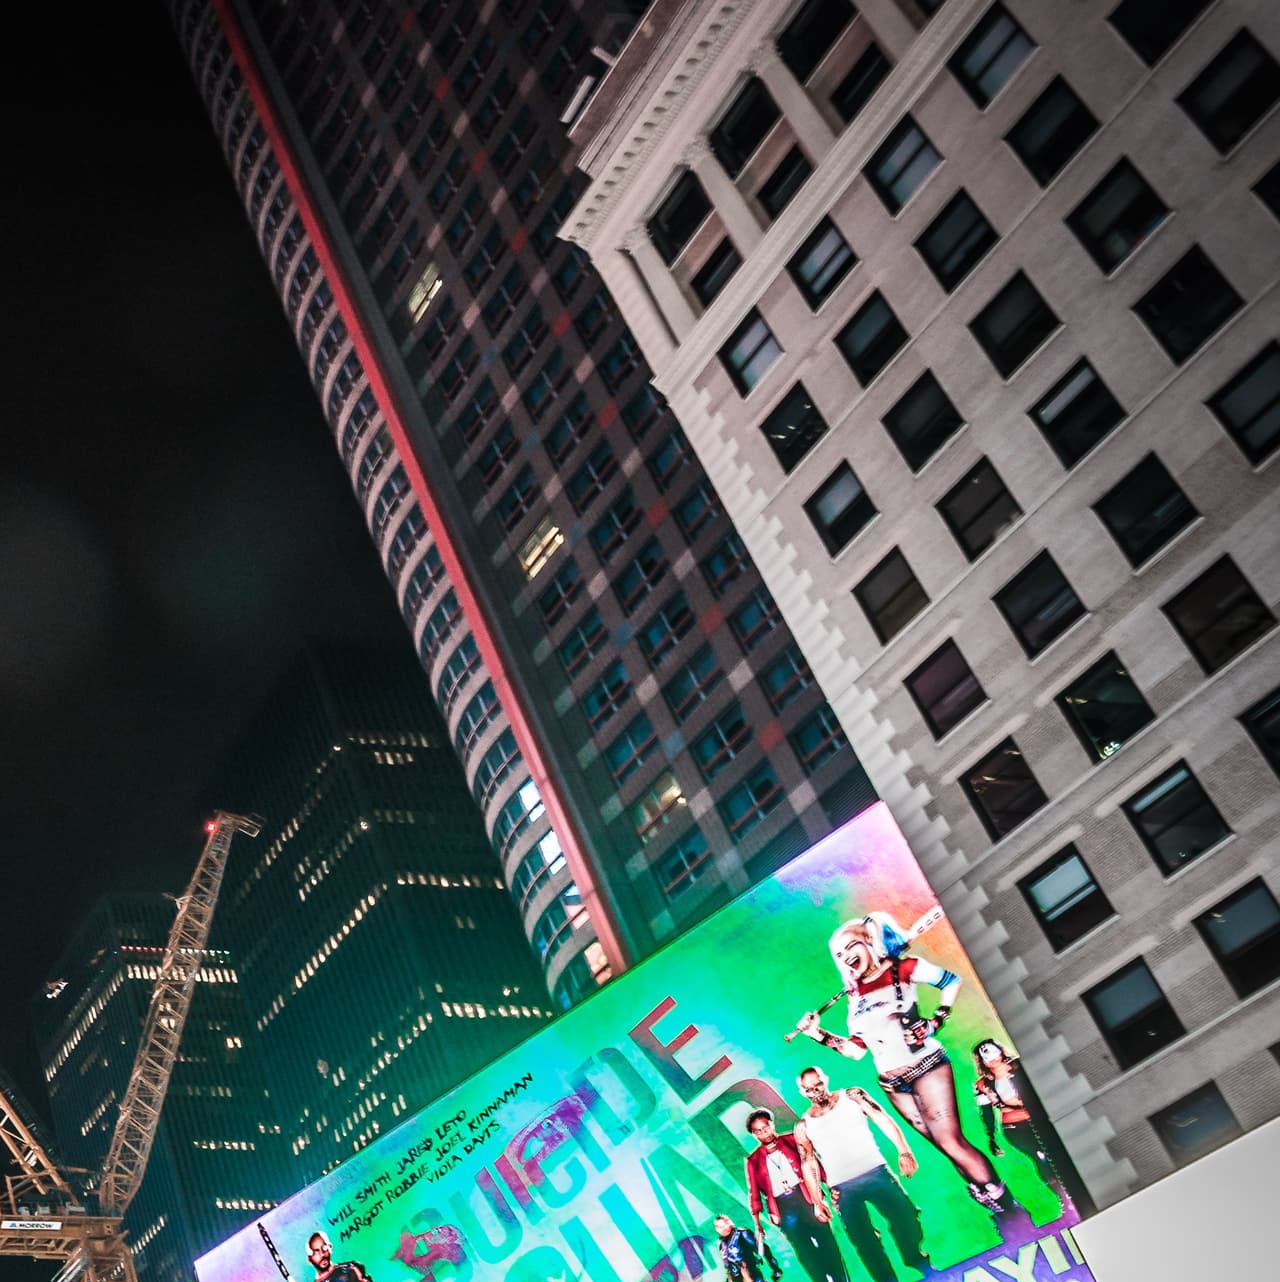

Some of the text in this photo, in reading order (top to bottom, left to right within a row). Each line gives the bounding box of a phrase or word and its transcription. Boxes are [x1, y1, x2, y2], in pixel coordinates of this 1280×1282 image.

[328, 1110, 467, 1227] WILL SMITH JARED LETO
[339, 1072, 534, 1243] MARGOT ROBBIE JOEL KINNAMAN
[426, 1119, 502, 1185] VIOLA DAVIS
